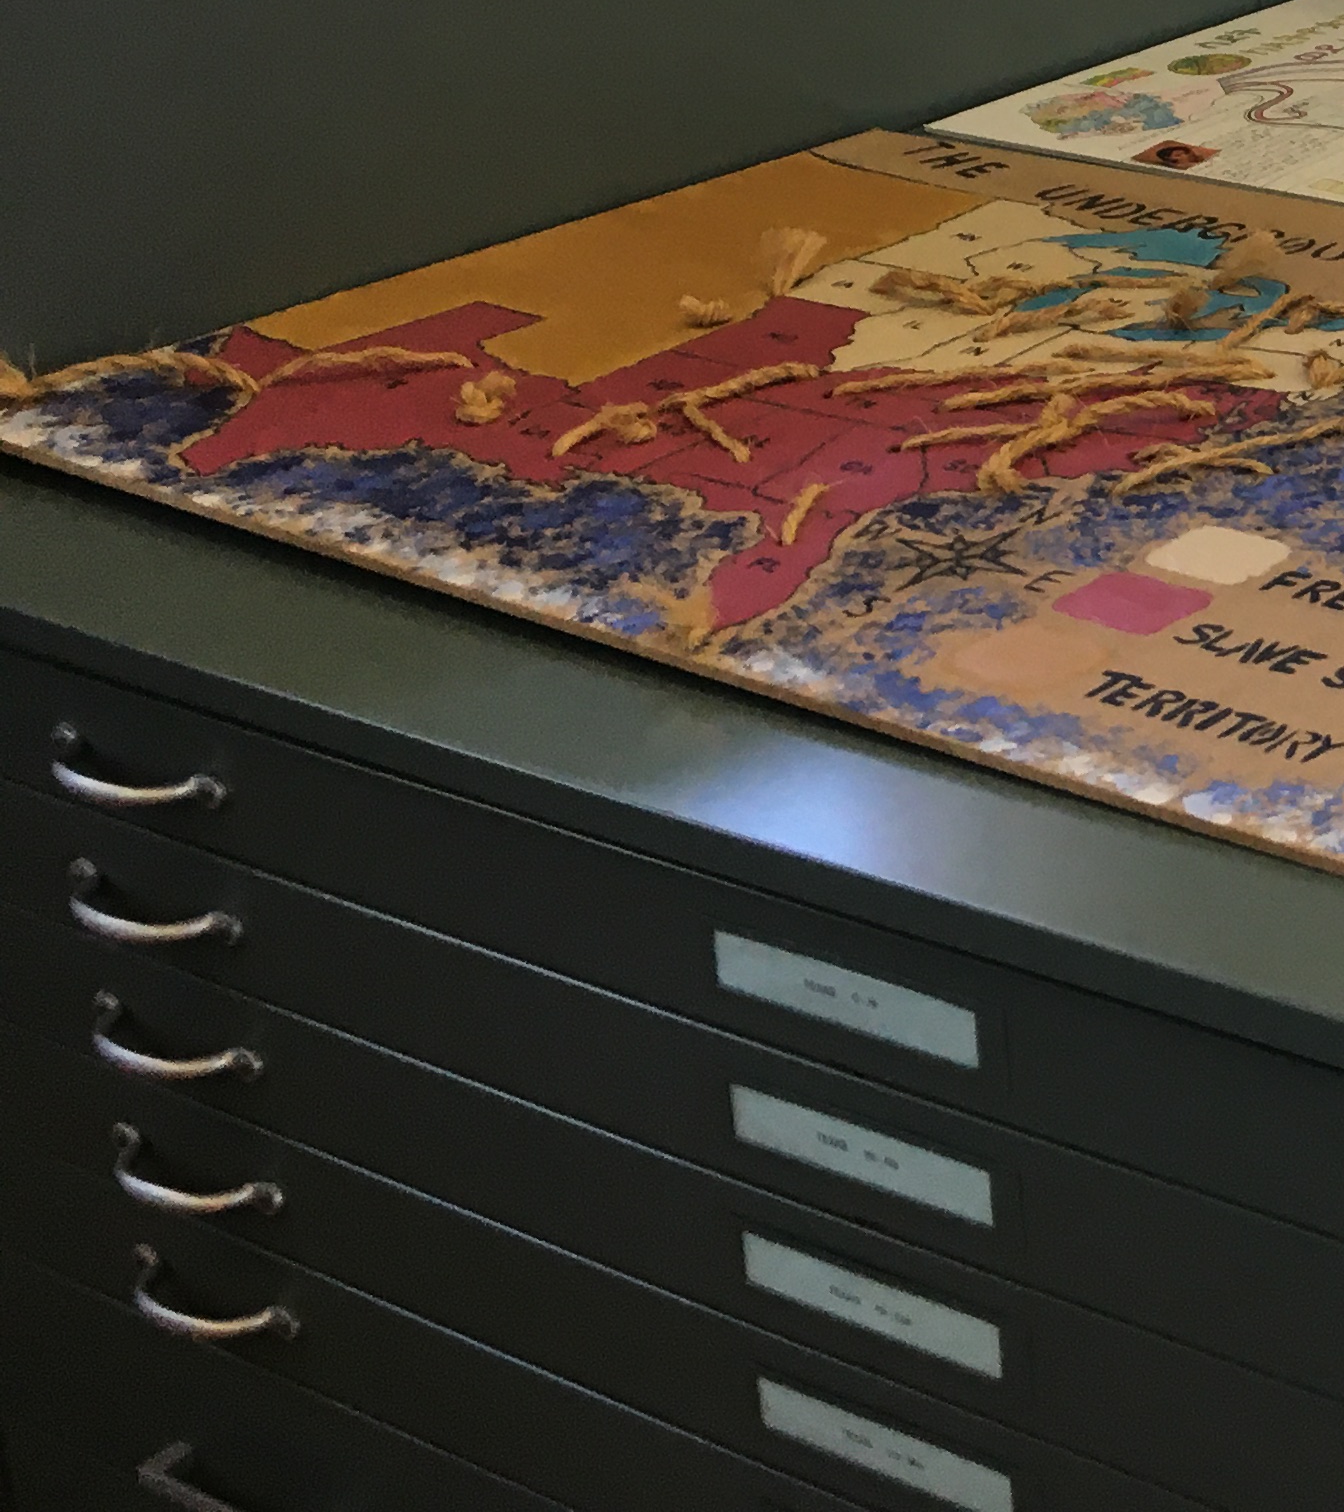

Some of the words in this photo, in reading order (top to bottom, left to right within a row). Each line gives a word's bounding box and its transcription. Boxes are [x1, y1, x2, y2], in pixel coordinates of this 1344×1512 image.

[903, 141, 1011, 180] THE
[1018, 505, 1064, 526] N
[1023, 570, 1077, 593] E
[842, 595, 892, 618] S
[1173, 623, 1329, 675] SLAVE
